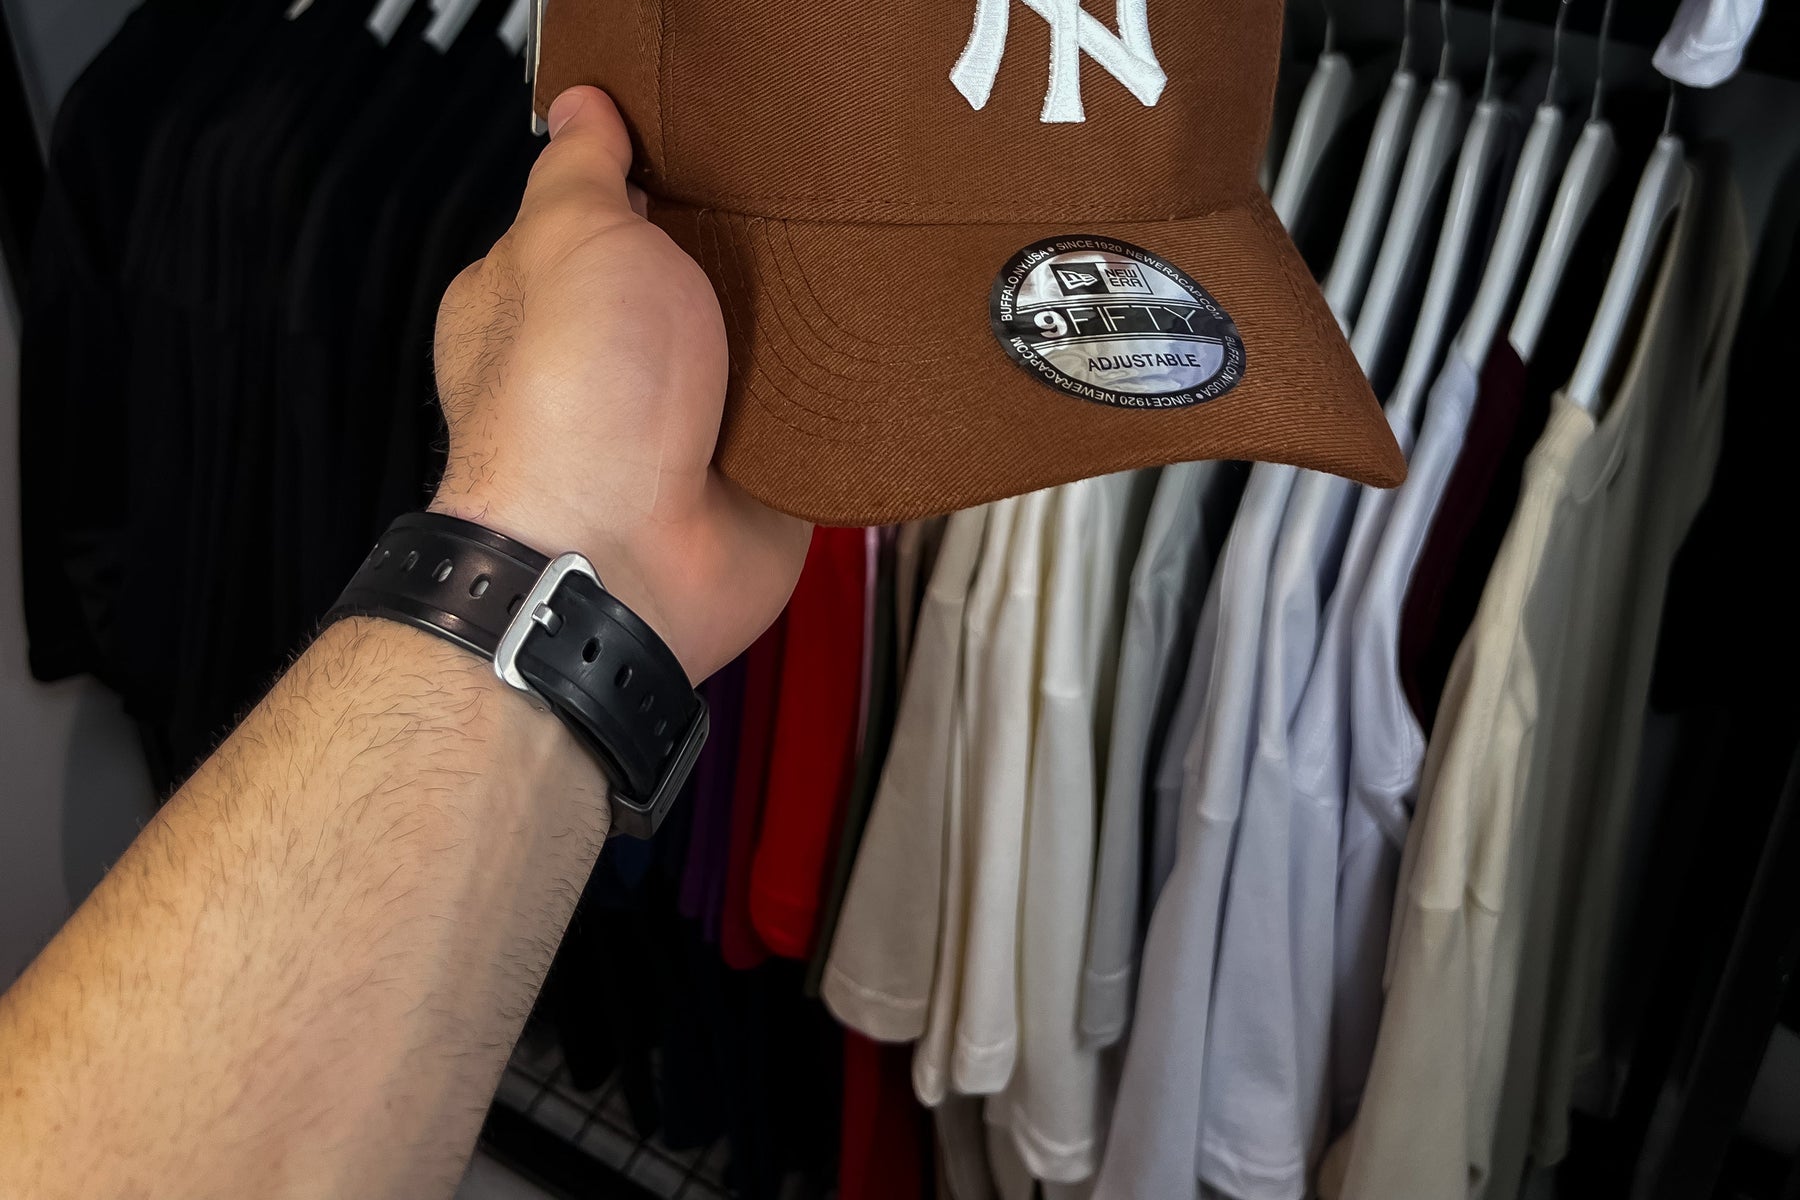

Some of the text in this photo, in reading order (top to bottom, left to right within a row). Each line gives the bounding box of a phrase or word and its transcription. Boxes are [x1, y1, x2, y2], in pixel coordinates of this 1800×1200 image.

[1104, 268, 1138, 278] NEW
[1109, 276, 1144, 288] ERA
[1088, 353, 1201, 372] ADJUSTABLE
